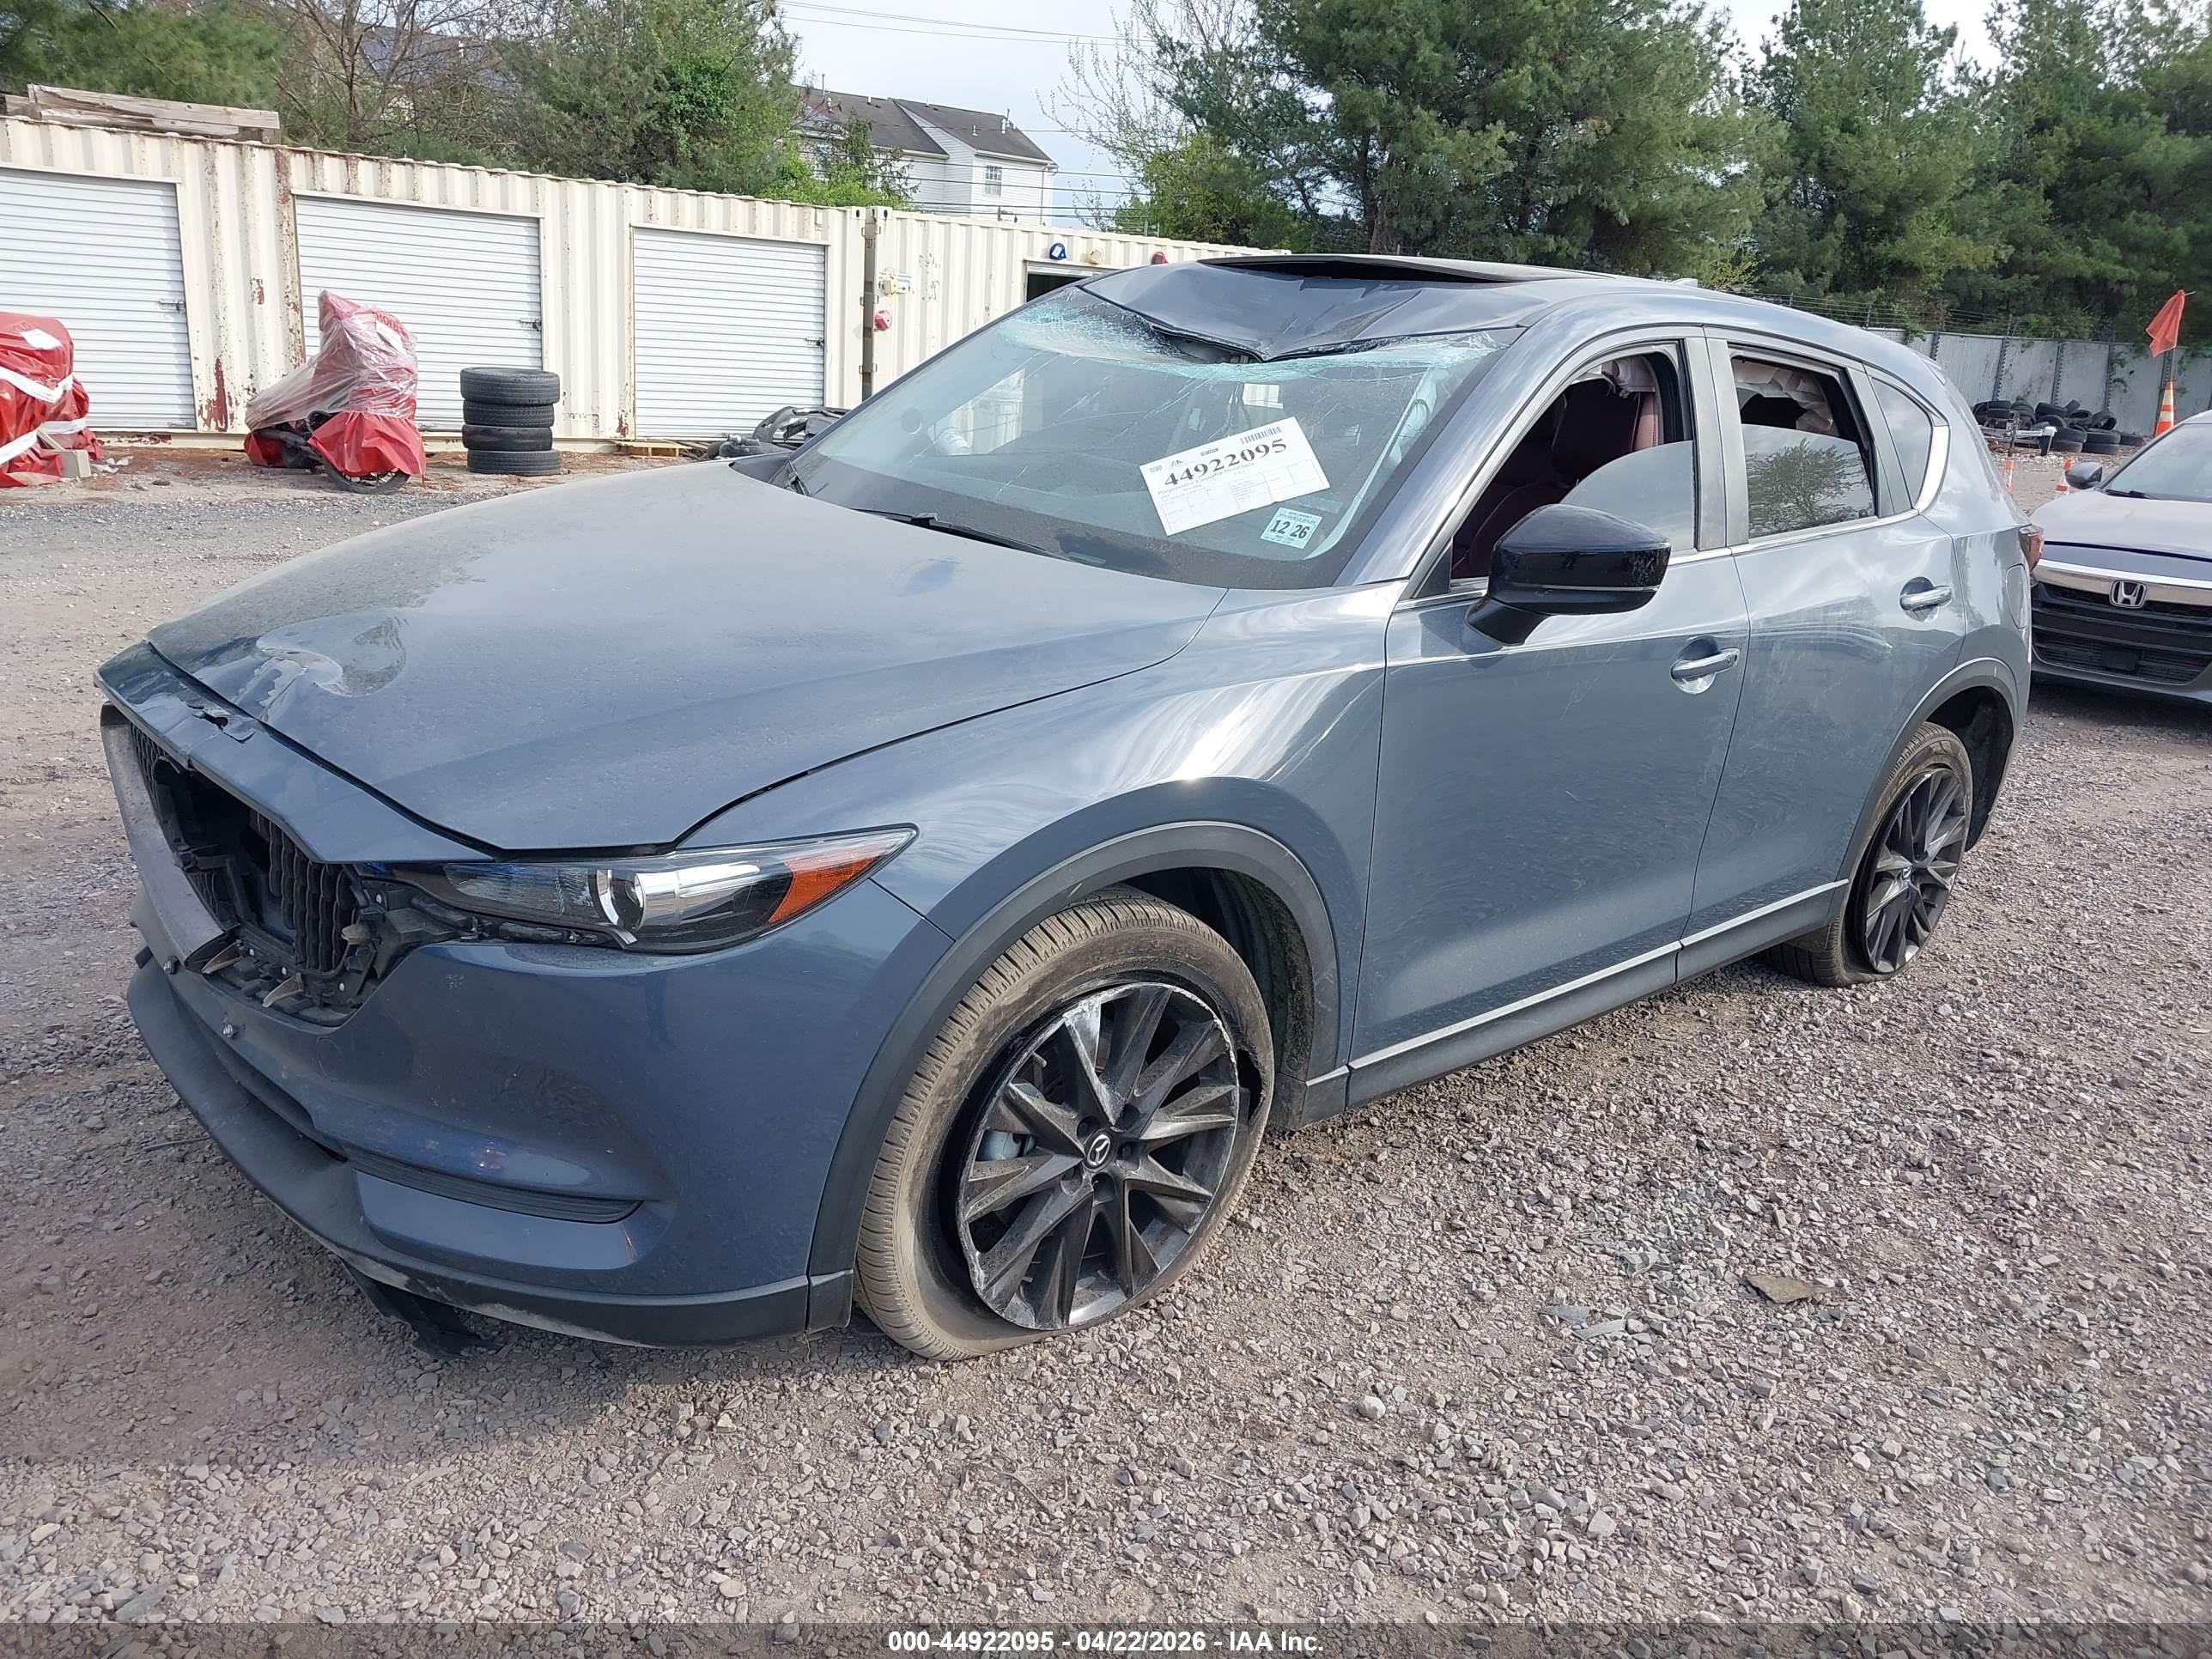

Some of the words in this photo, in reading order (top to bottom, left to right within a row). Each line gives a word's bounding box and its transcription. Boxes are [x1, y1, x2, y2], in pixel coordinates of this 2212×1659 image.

[1164, 439, 1286, 485] 44922095
[1270, 520, 1291, 534] 12
[1290, 525, 1310, 538] 26
